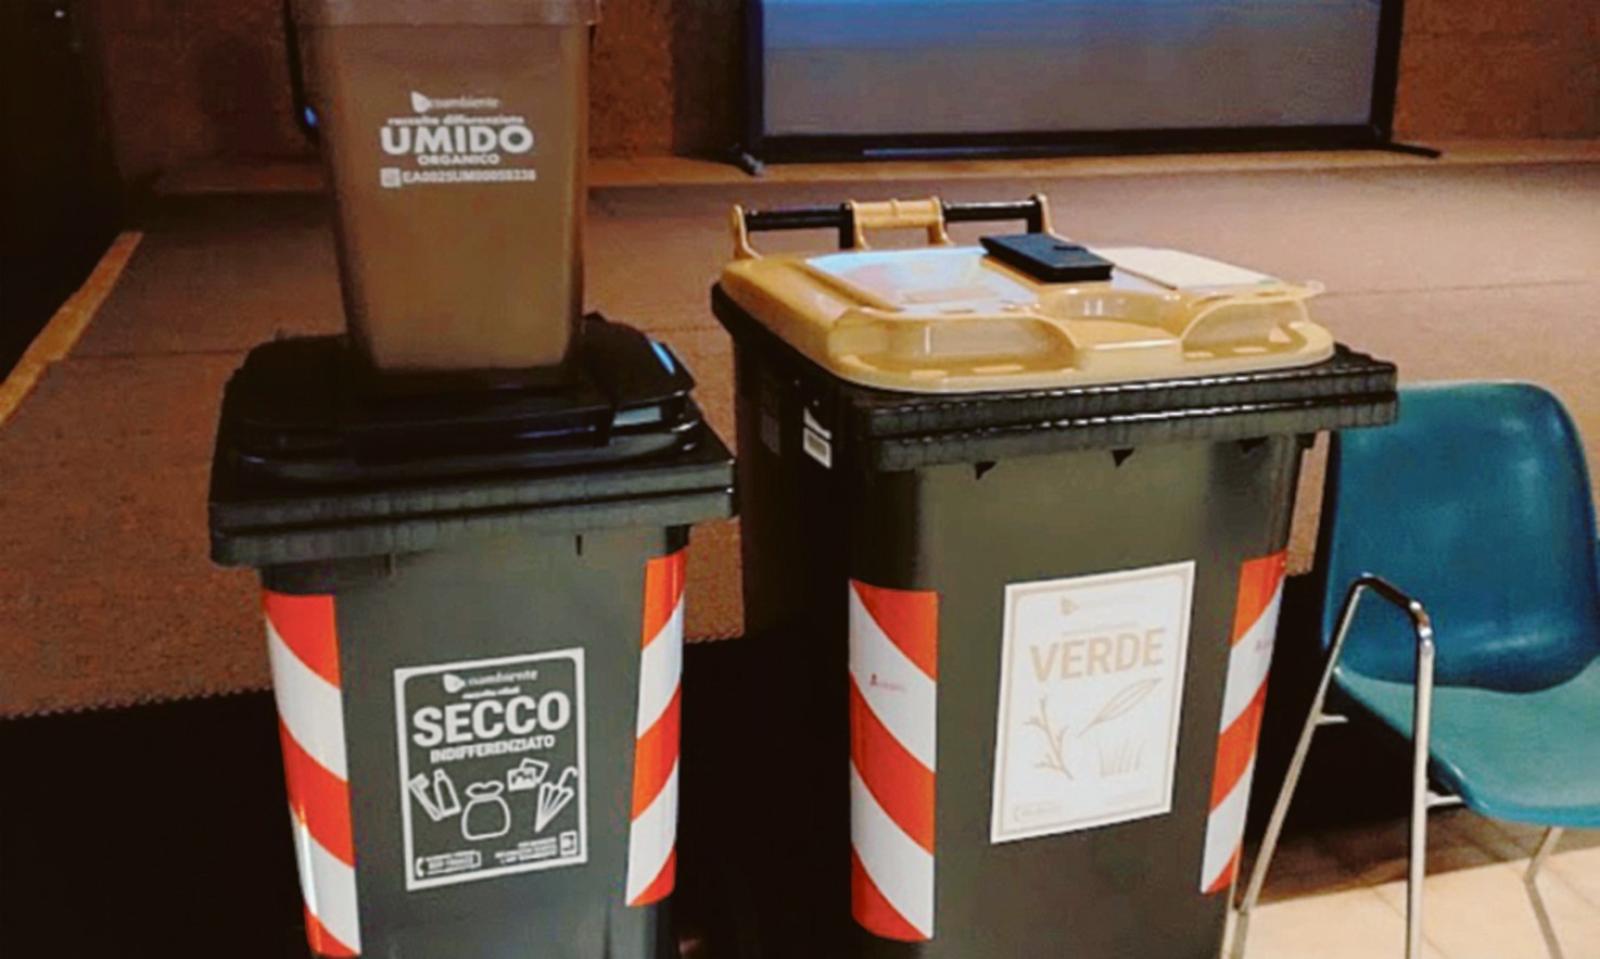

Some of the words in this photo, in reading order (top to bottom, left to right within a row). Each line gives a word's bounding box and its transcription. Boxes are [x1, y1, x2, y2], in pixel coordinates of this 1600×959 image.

[379, 125, 534, 155] UMIDO
[417, 154, 500, 166] ORGANICO
[1028, 627, 1166, 683] VERDE
[411, 690, 571, 747] SECCO
[429, 734, 556, 764] INDIFFERENZIATO
